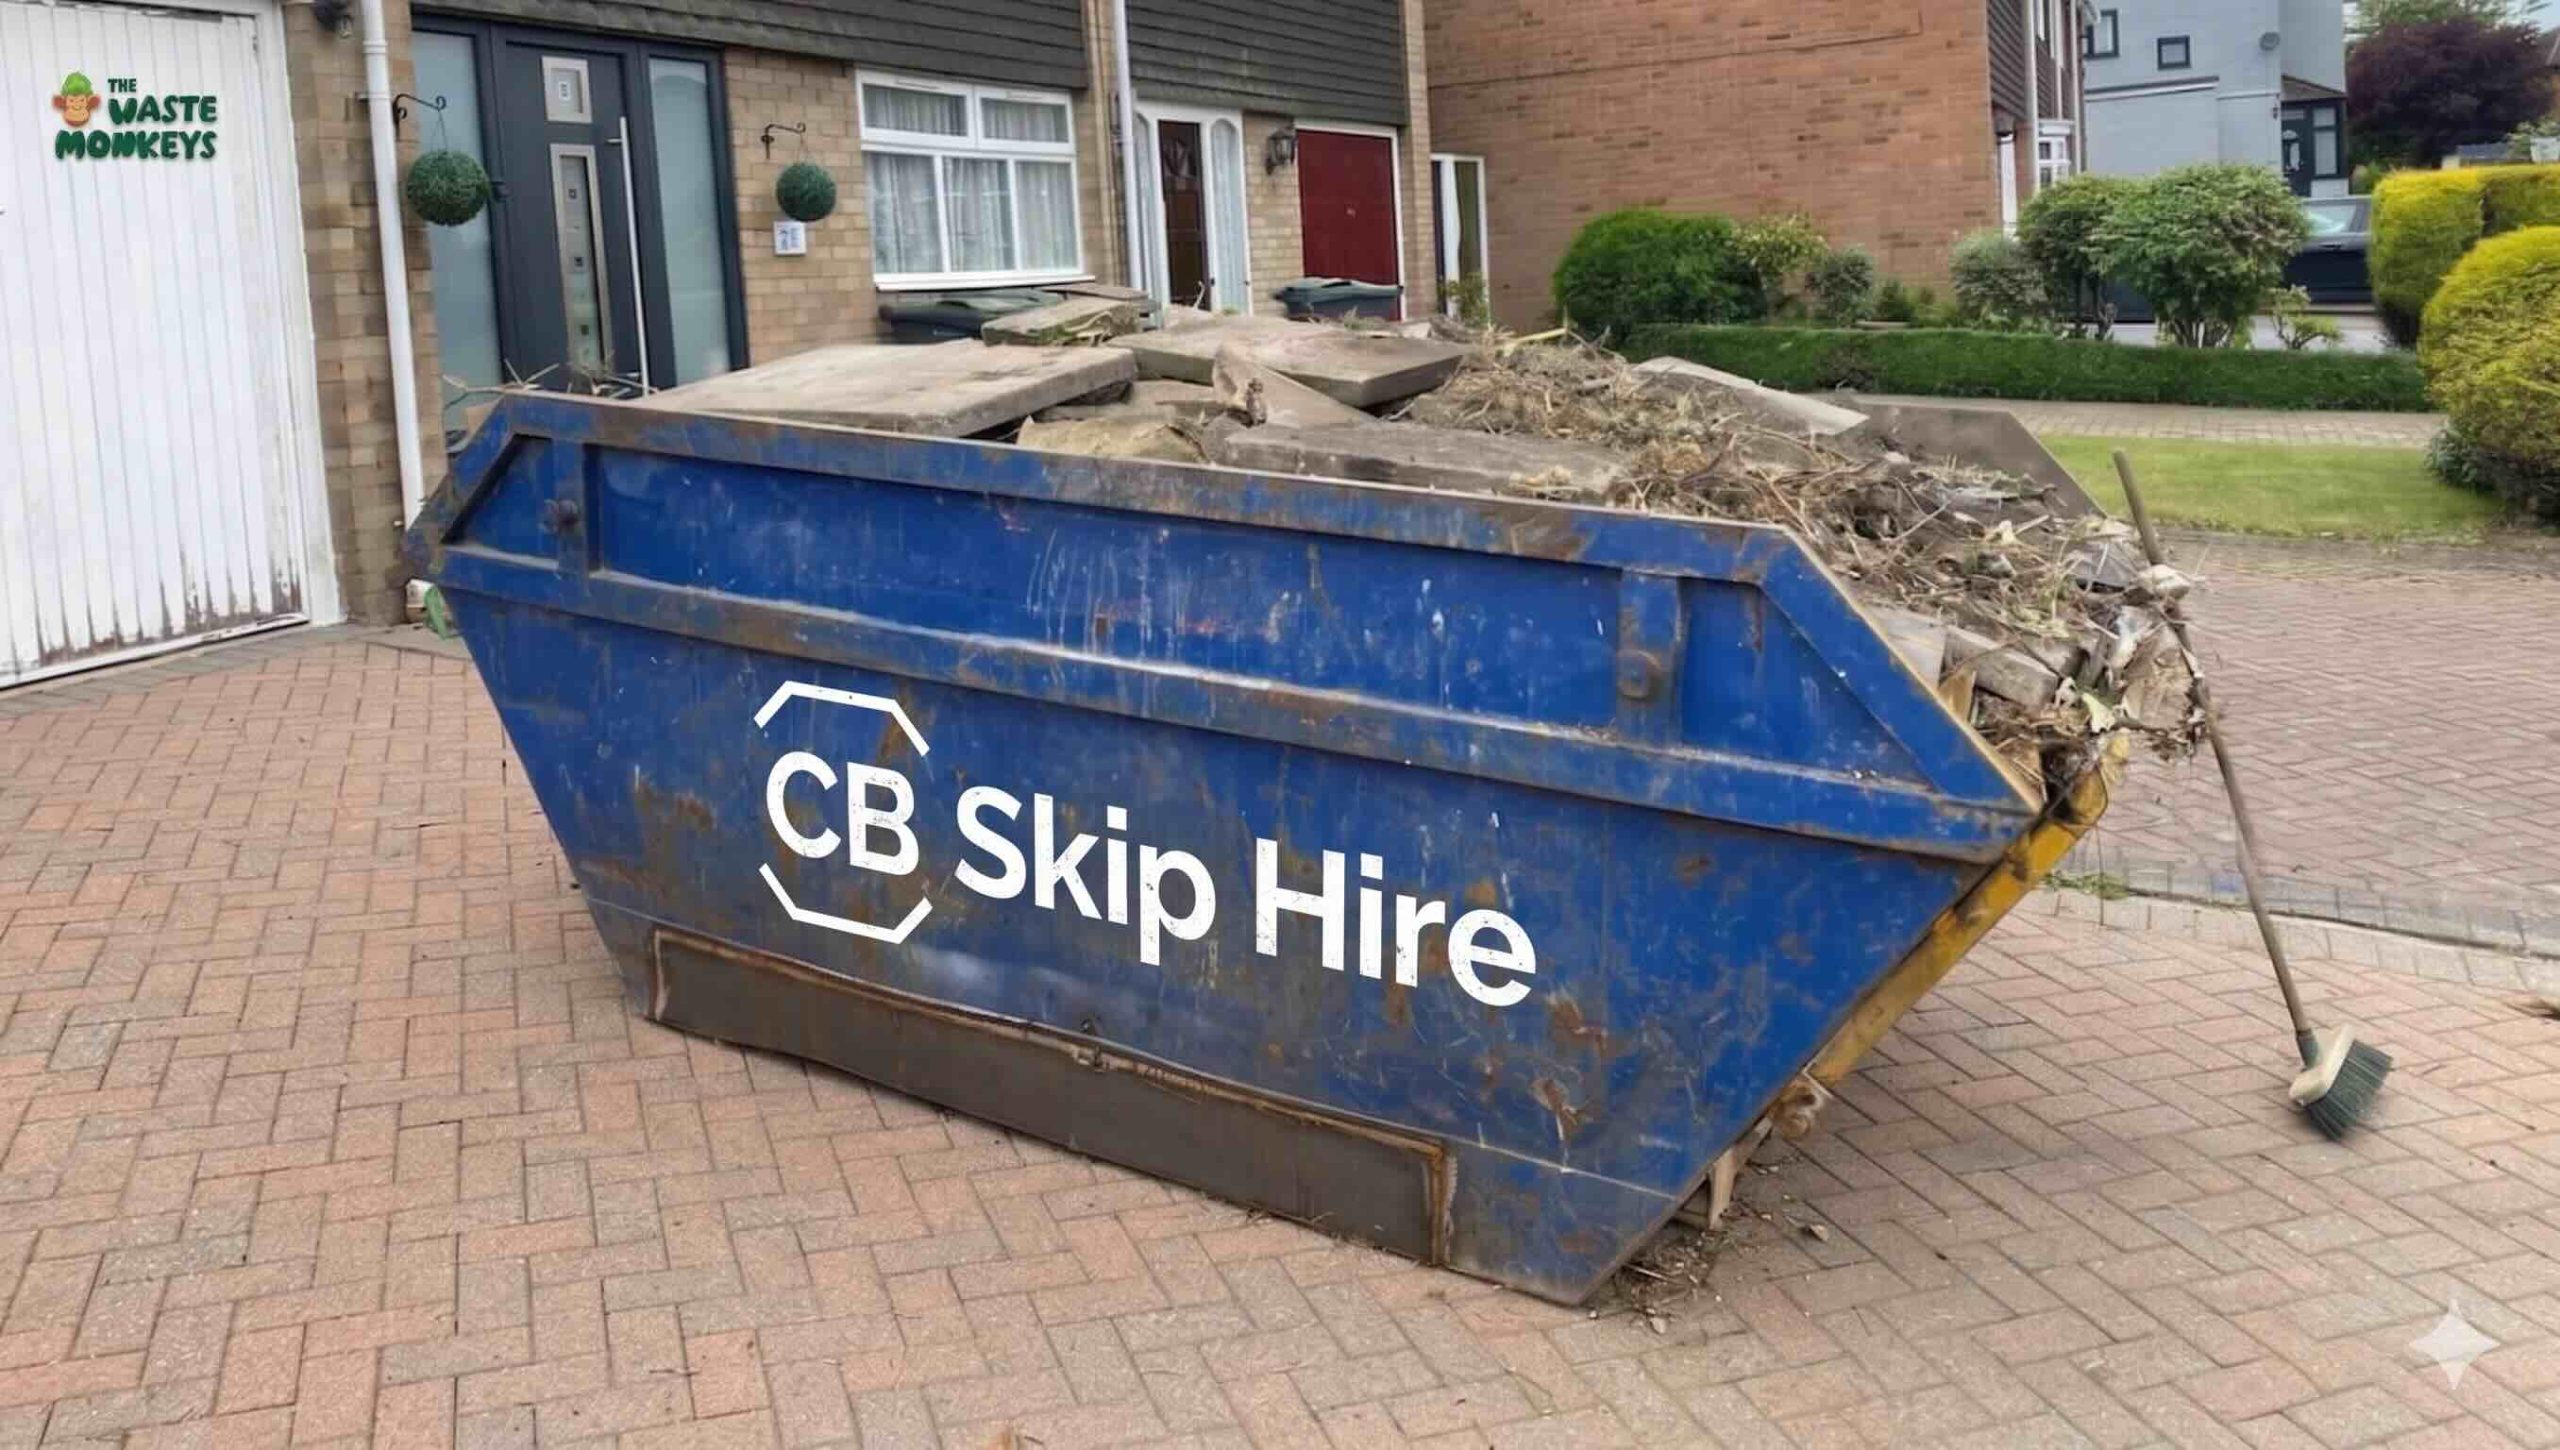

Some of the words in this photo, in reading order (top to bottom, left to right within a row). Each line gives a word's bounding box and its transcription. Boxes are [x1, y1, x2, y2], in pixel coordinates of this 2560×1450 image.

[766, 751, 919, 876] CB
[955, 786, 1216, 966] Skip
[1256, 837, 1536, 1007] Hire
